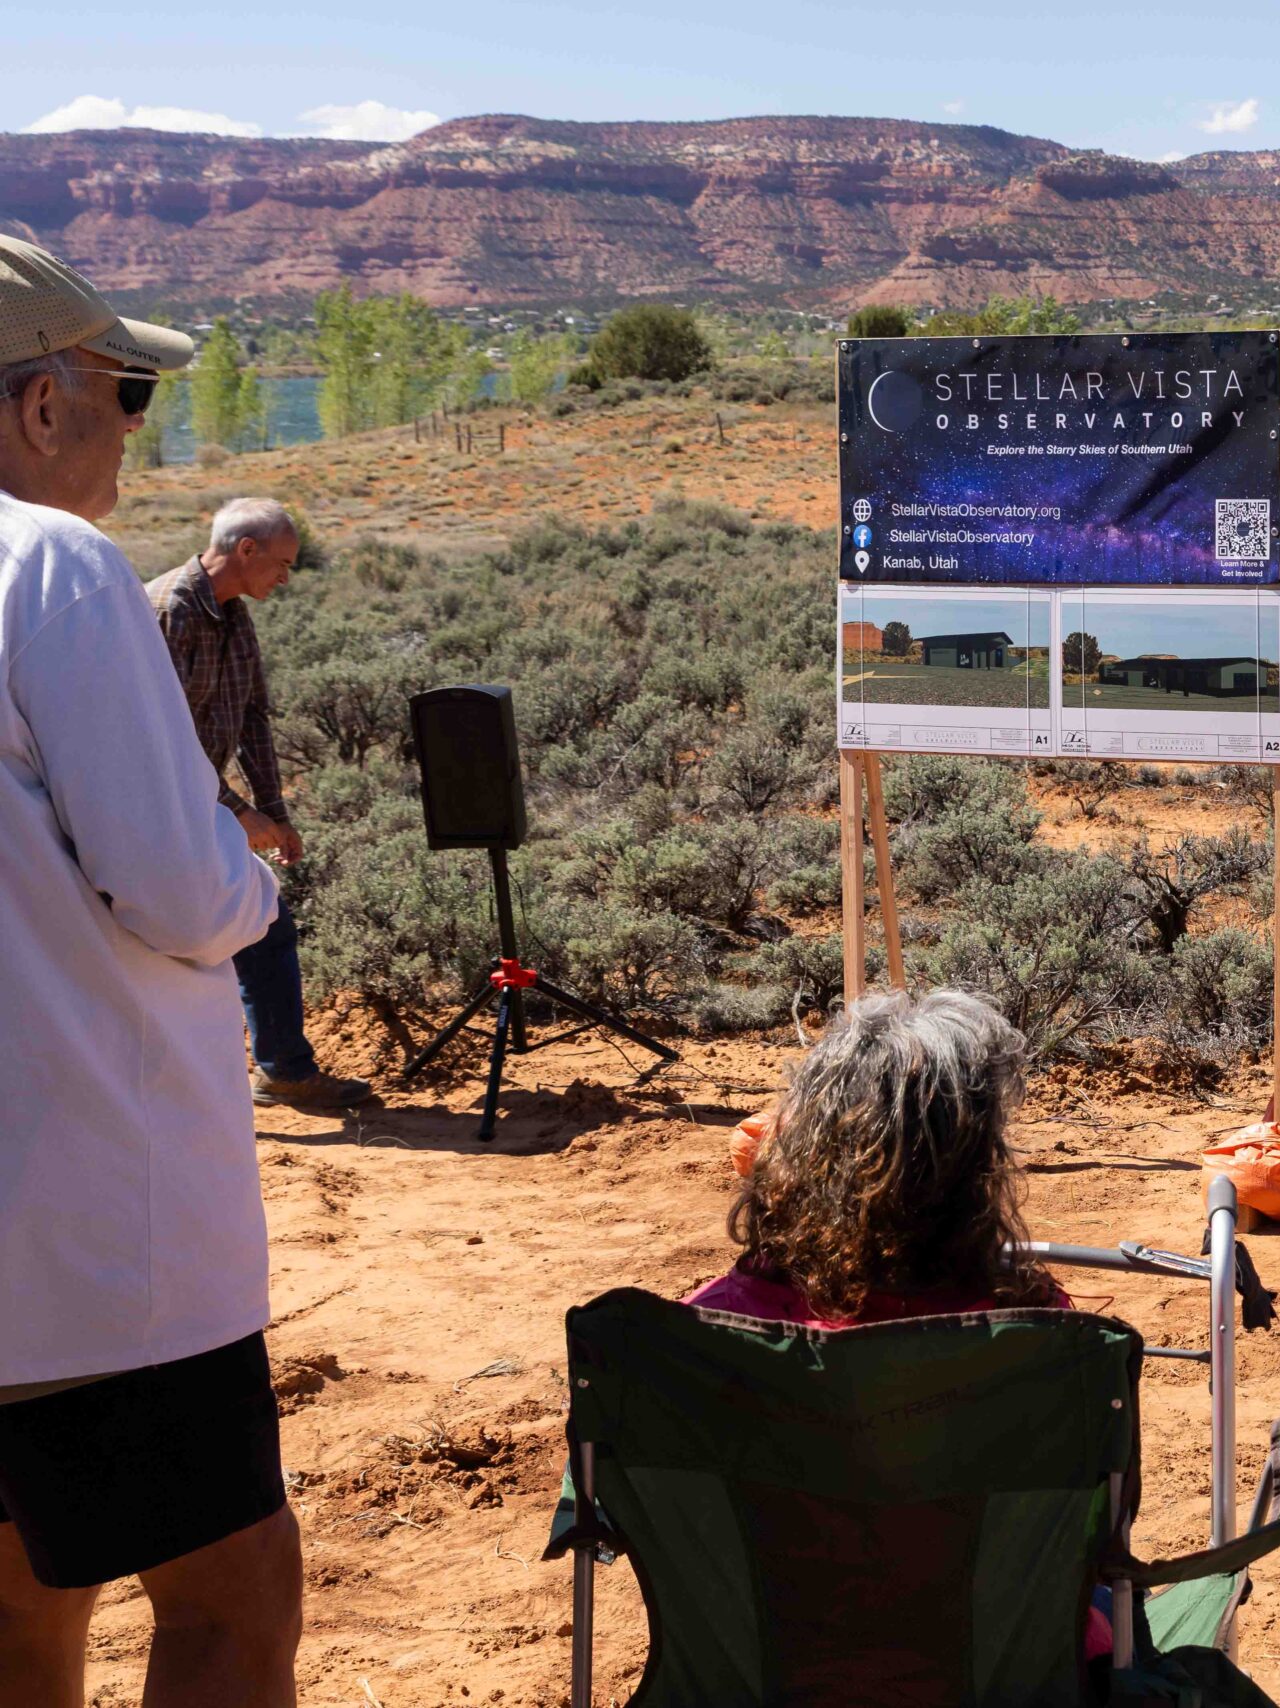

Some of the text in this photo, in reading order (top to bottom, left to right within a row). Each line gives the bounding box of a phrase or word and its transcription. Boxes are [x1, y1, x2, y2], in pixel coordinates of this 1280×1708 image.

[106, 340, 161, 364] ALL OUTER
[935, 370, 1244, 401] STELLAR VISTA
[936, 411, 1245, 430] OBSERVATORY
[987, 443, 1193, 456] Explore the Starry Skies of Southern Utah
[891, 504, 1061, 520] StellarVistaObservatory.org
[890, 530, 1034, 546] StellarVistaObservatory
[883, 556, 959, 571] Kanab, Utah
[1035, 735, 1048, 744] A1
[1265, 741, 1280, 751] A2
